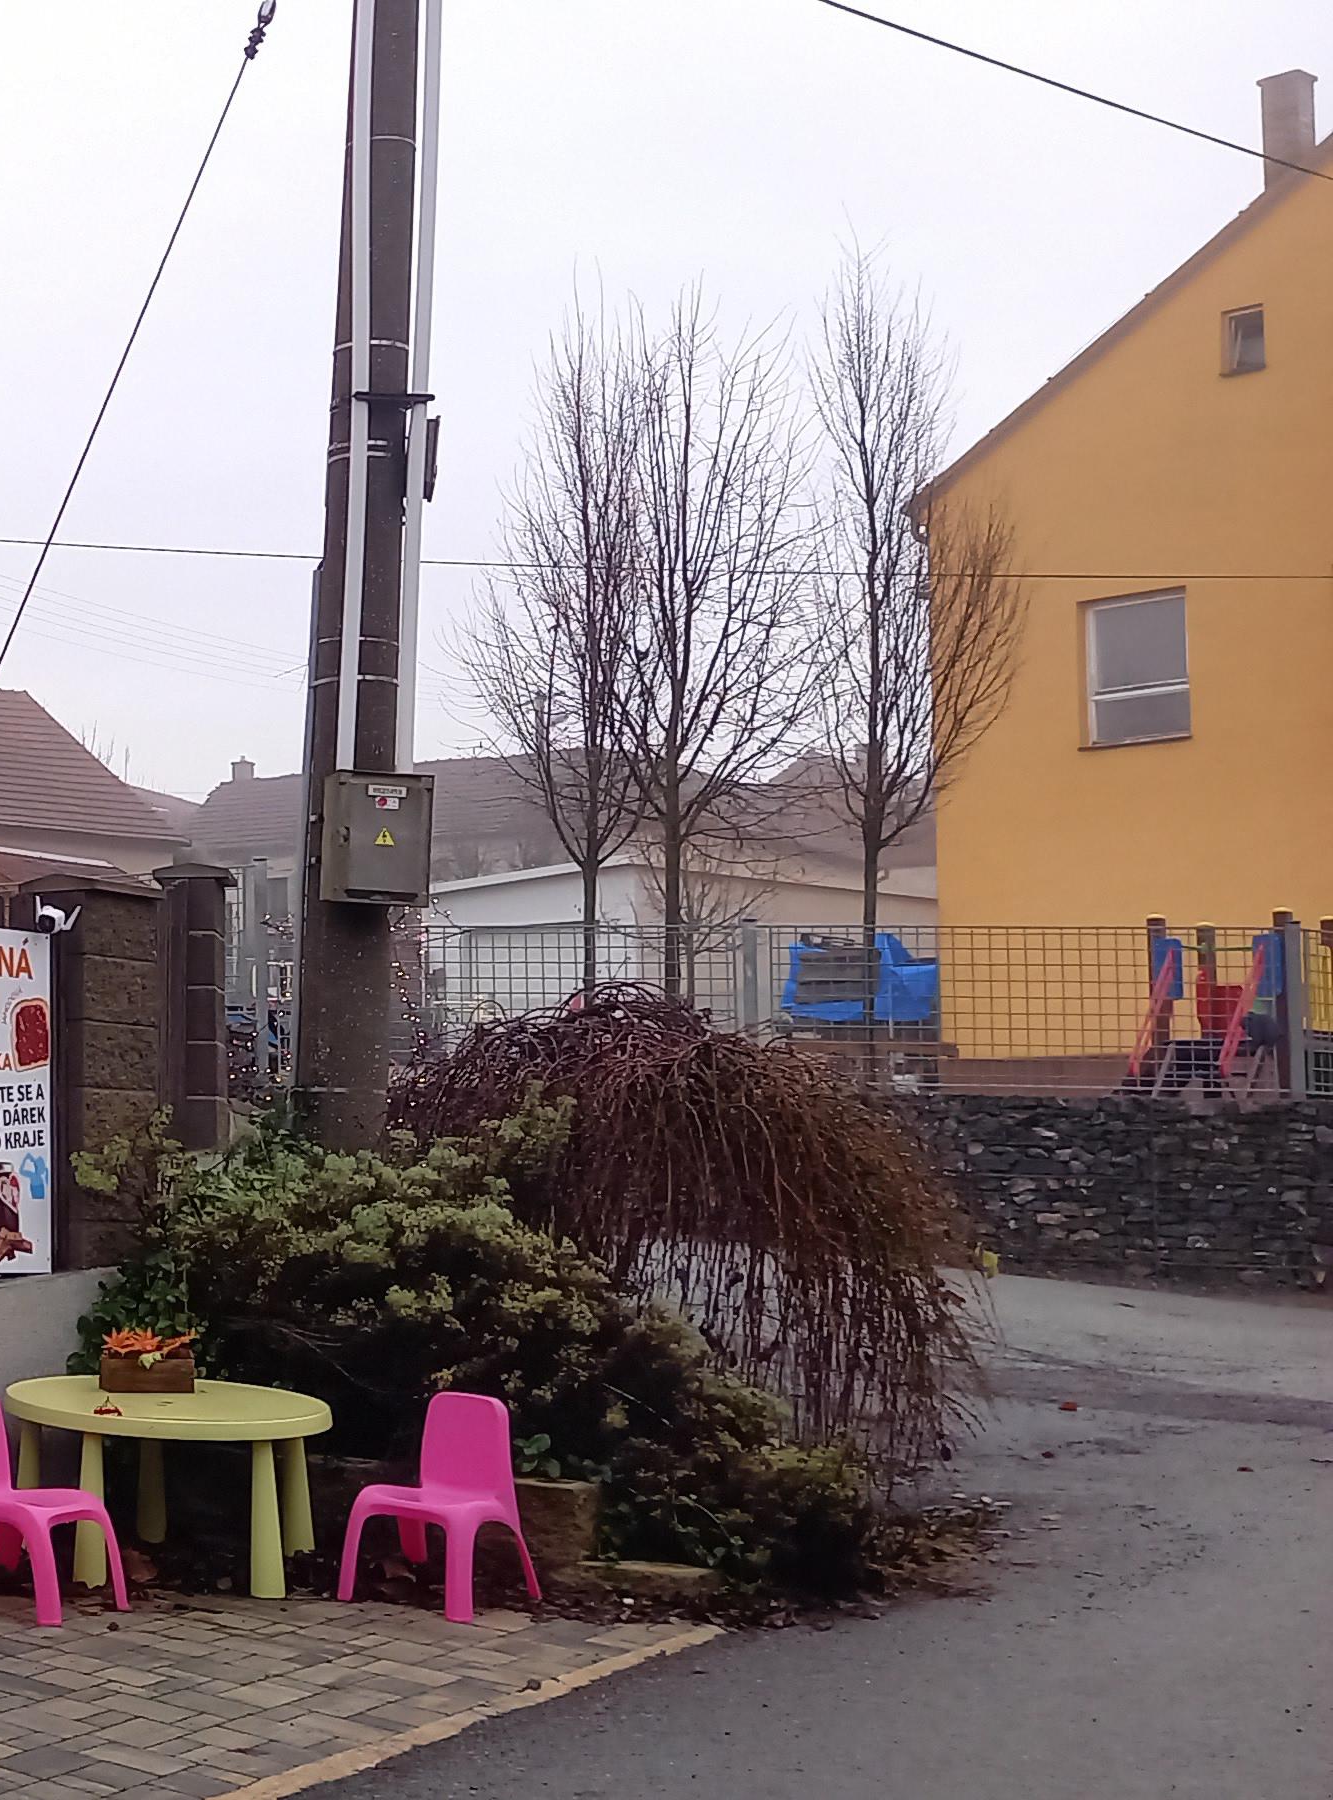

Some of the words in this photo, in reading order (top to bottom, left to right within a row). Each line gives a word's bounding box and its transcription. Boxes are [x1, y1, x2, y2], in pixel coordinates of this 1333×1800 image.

[18, 1085, 33, 1101] SE
[36, 1084, 44, 1100] A
[3, 1104, 45, 1126] DÁREK
[5, 1130, 45, 1149] KRAJE
